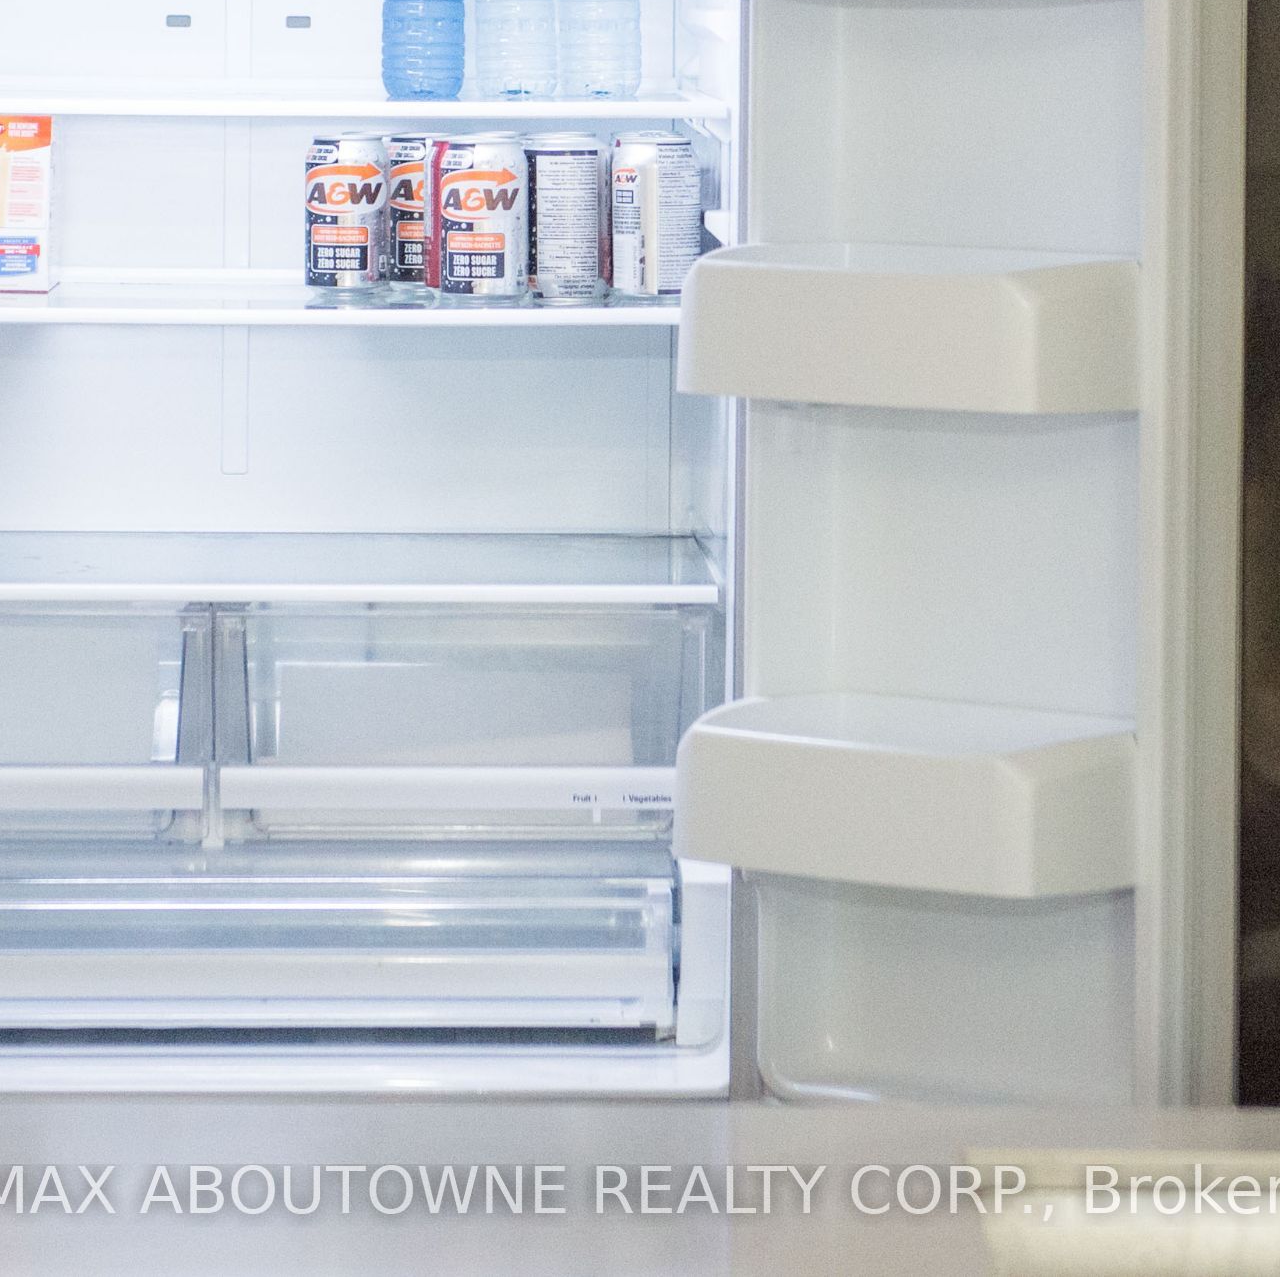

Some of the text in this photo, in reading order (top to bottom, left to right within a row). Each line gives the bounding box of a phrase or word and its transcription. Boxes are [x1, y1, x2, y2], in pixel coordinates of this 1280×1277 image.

[307, 181, 383, 206] A&W
[442, 187, 520, 212] A&W
[317, 247, 361, 258] ZERO SUGAR
[404, 243, 423, 253] ZERO
[335, 258, 360, 269] SUCRE
[452, 254, 497, 265] ZERO SUGAR
[471, 266, 497, 277] SUCRE
[628, 794, 672, 804] Vegetables
